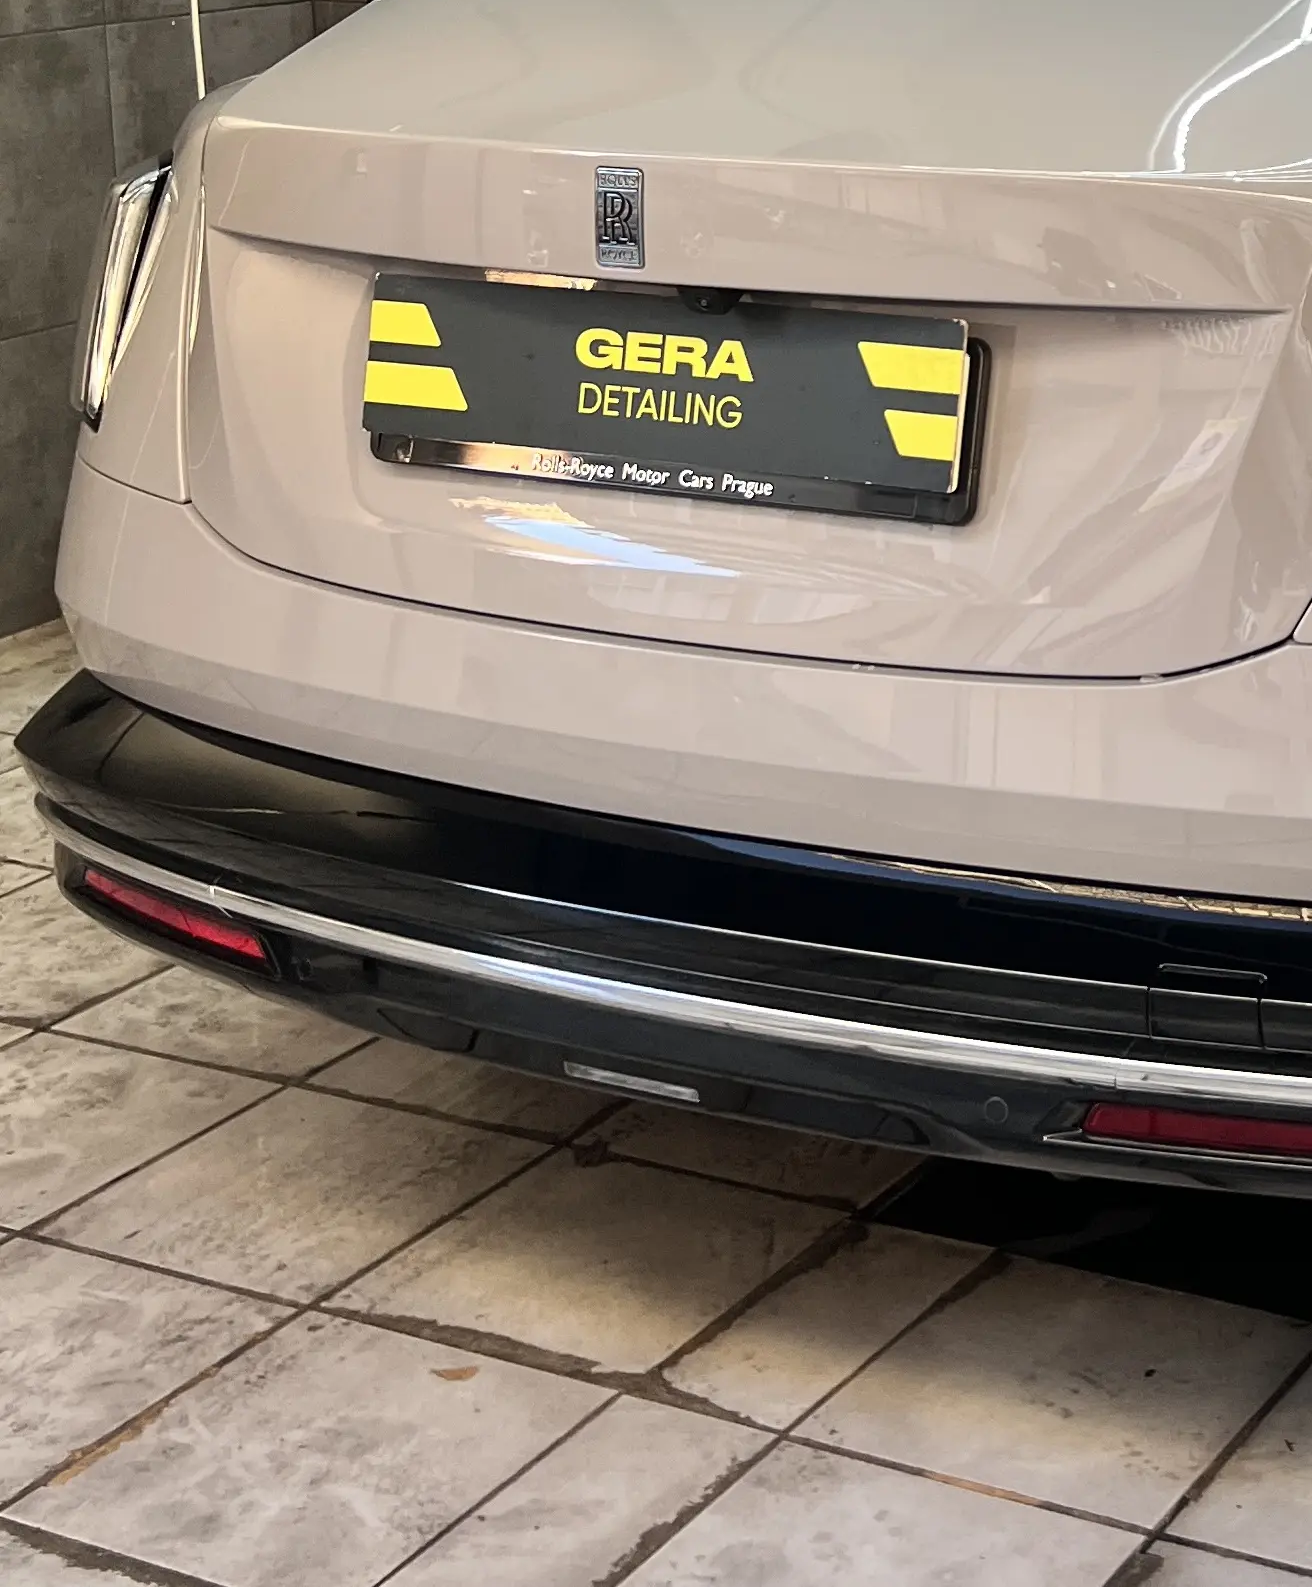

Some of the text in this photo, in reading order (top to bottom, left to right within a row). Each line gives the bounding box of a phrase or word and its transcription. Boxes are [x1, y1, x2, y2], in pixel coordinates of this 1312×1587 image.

[575, 328, 754, 382] GERA
[578, 382, 742, 428] DETAILING
[532, 453, 774, 498] Rolls-Royce Motor Cars Prague
